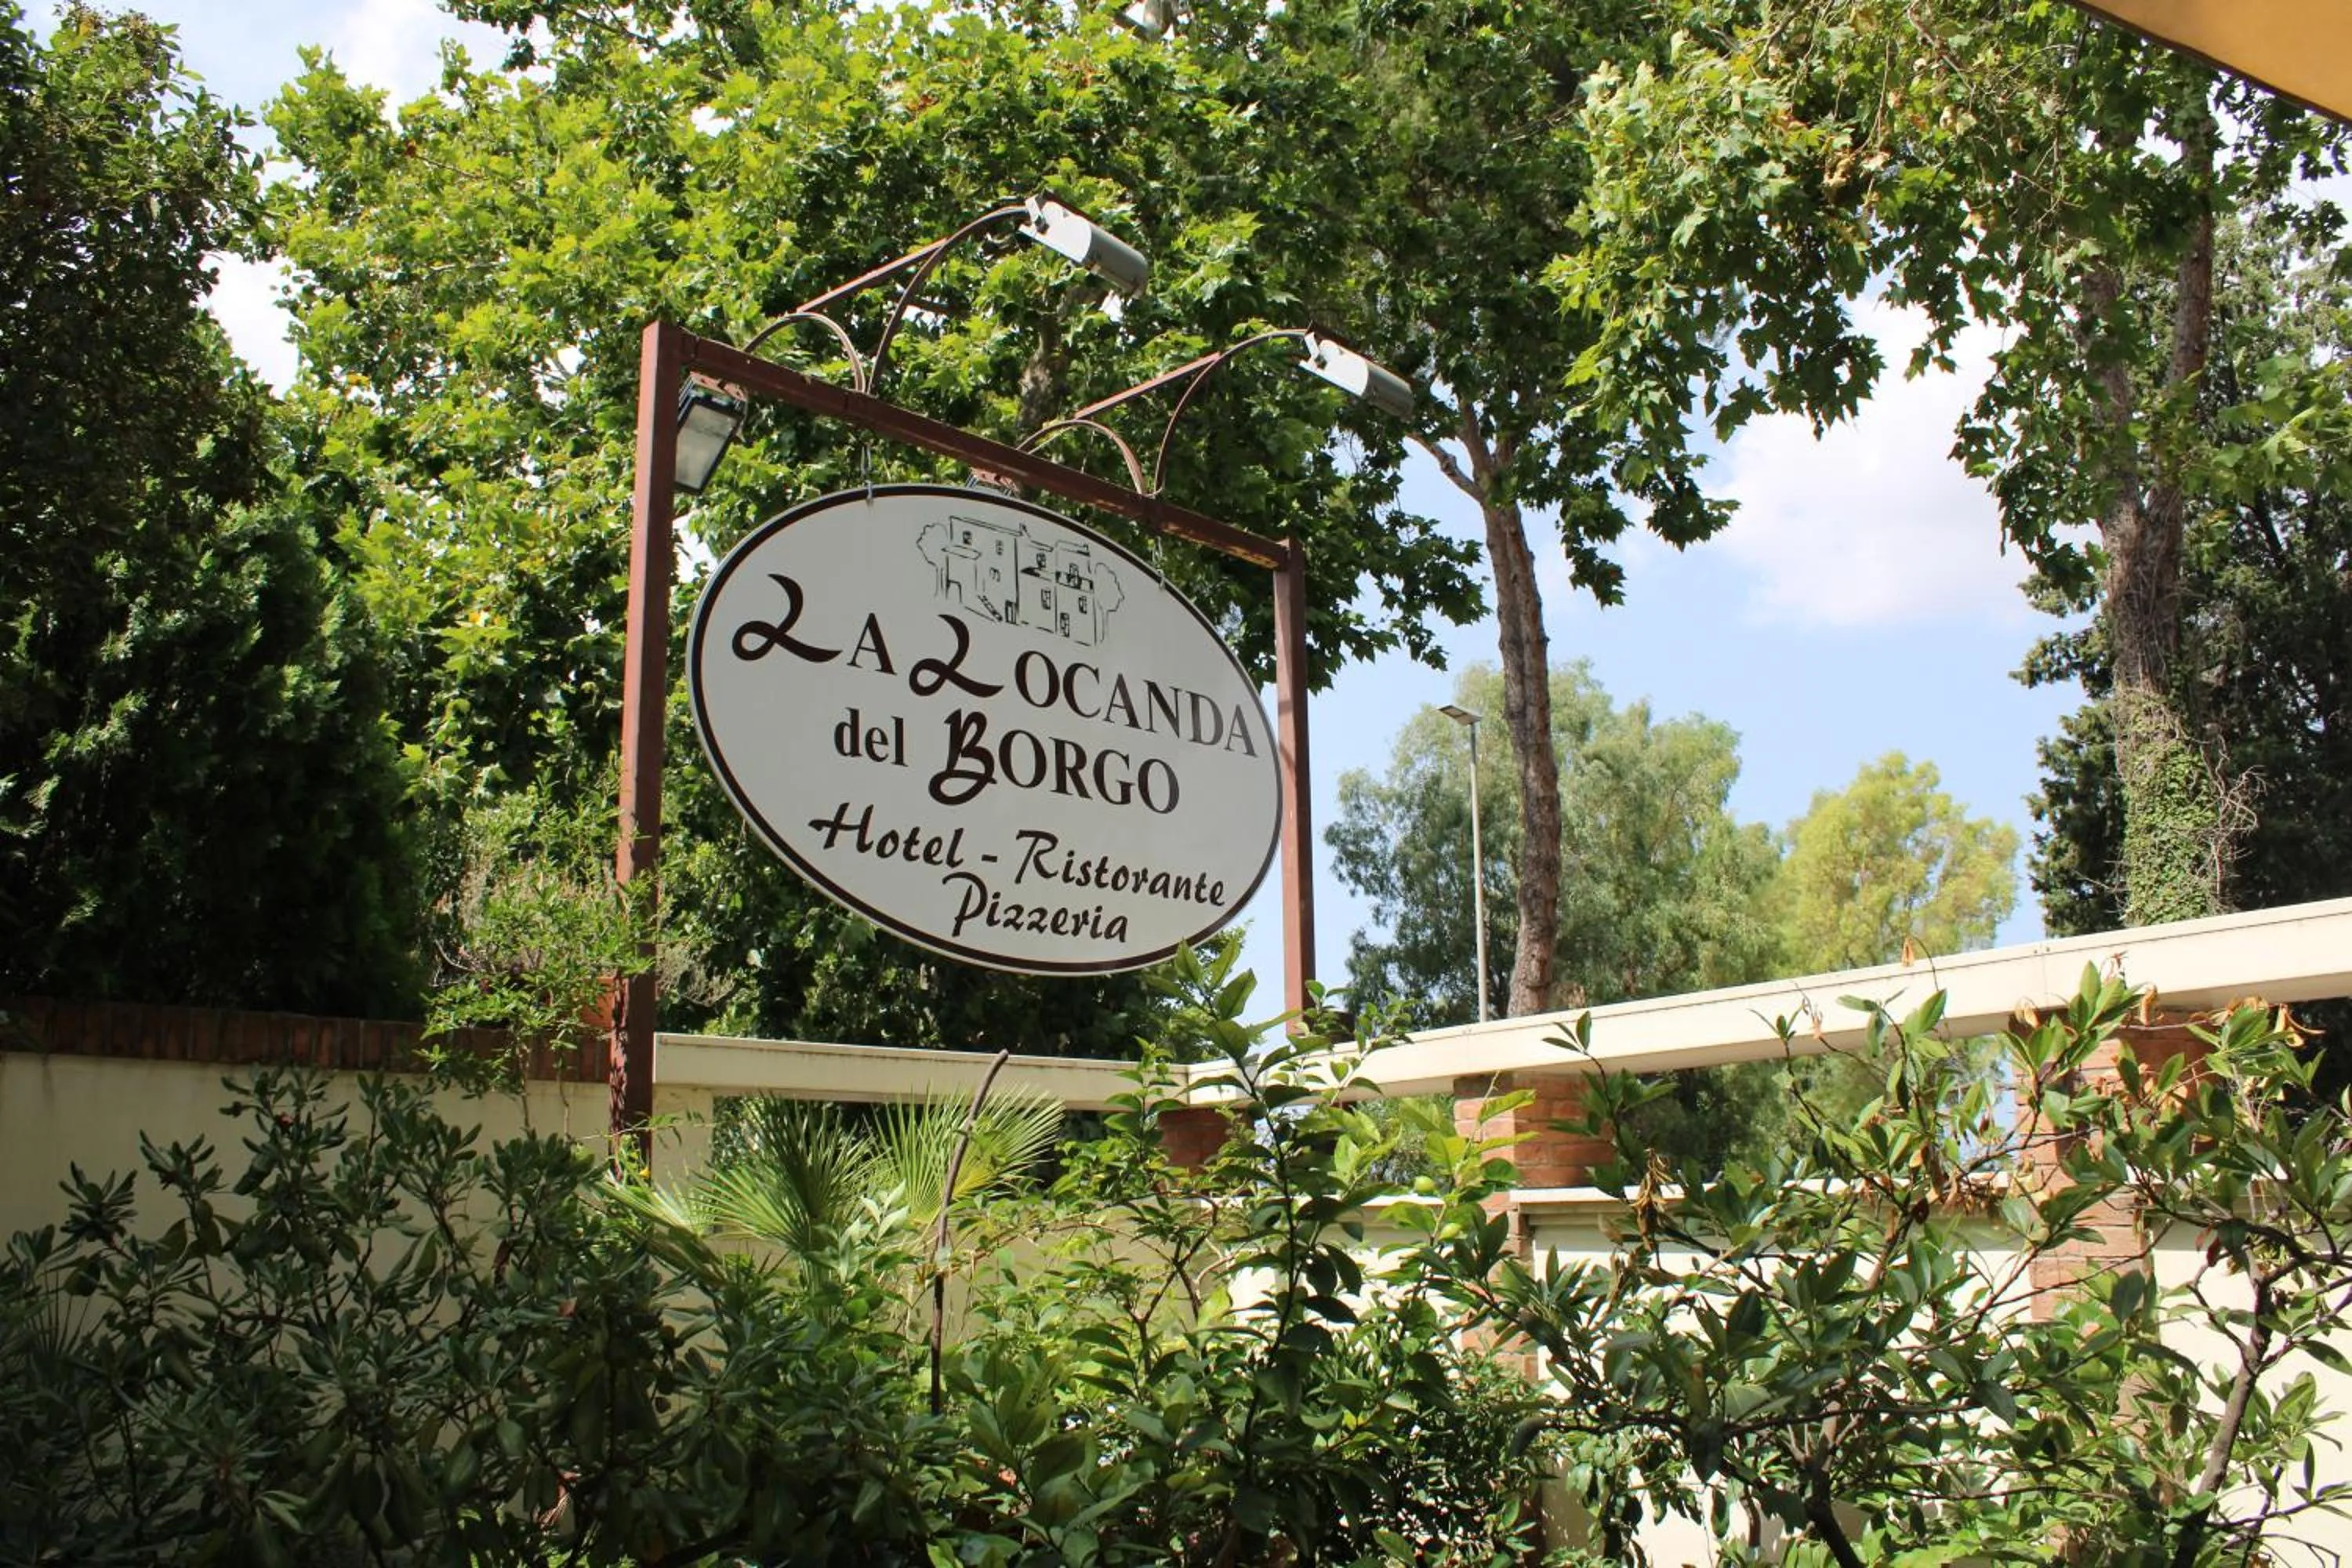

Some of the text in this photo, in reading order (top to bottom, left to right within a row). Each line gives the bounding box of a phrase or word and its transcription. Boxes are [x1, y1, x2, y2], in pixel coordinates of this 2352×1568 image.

[909, 614, 1259, 757] LOCANDA
[834, 707, 1180, 815] del BORGO
[808, 802, 964, 868] Hotel
[1015, 829, 1226, 907] Ristorante
[942, 872, 1129, 942] Pizzeria
